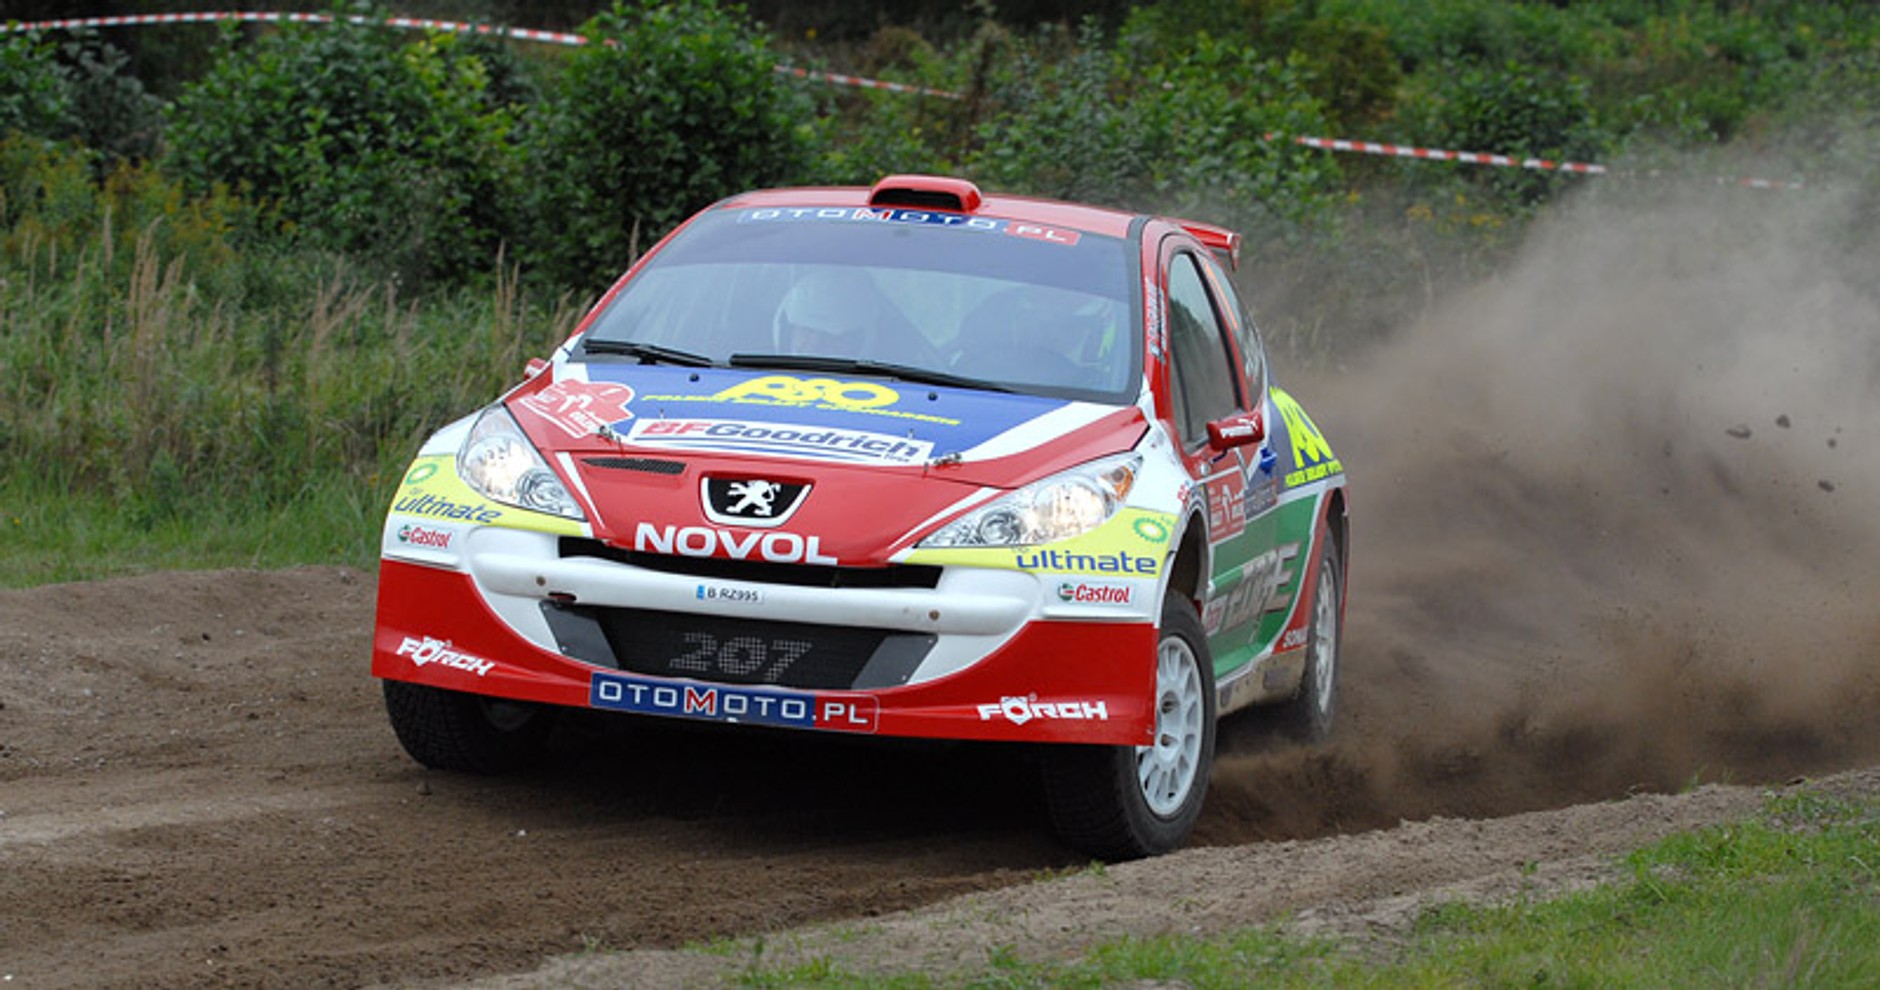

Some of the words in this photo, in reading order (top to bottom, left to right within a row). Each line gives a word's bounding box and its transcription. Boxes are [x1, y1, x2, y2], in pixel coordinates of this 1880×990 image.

[641, 422, 919, 457] BFGoodrich
[395, 494, 502, 523] ultimate
[410, 527, 452, 548] Castrol
[635, 522, 837, 565] NOVOL
[1017, 550, 1157, 574] ultimate
[1075, 583, 1130, 603] Castrol
[671, 632, 812, 681] 207
[599, 681, 868, 725] OTOMOTO.PL
